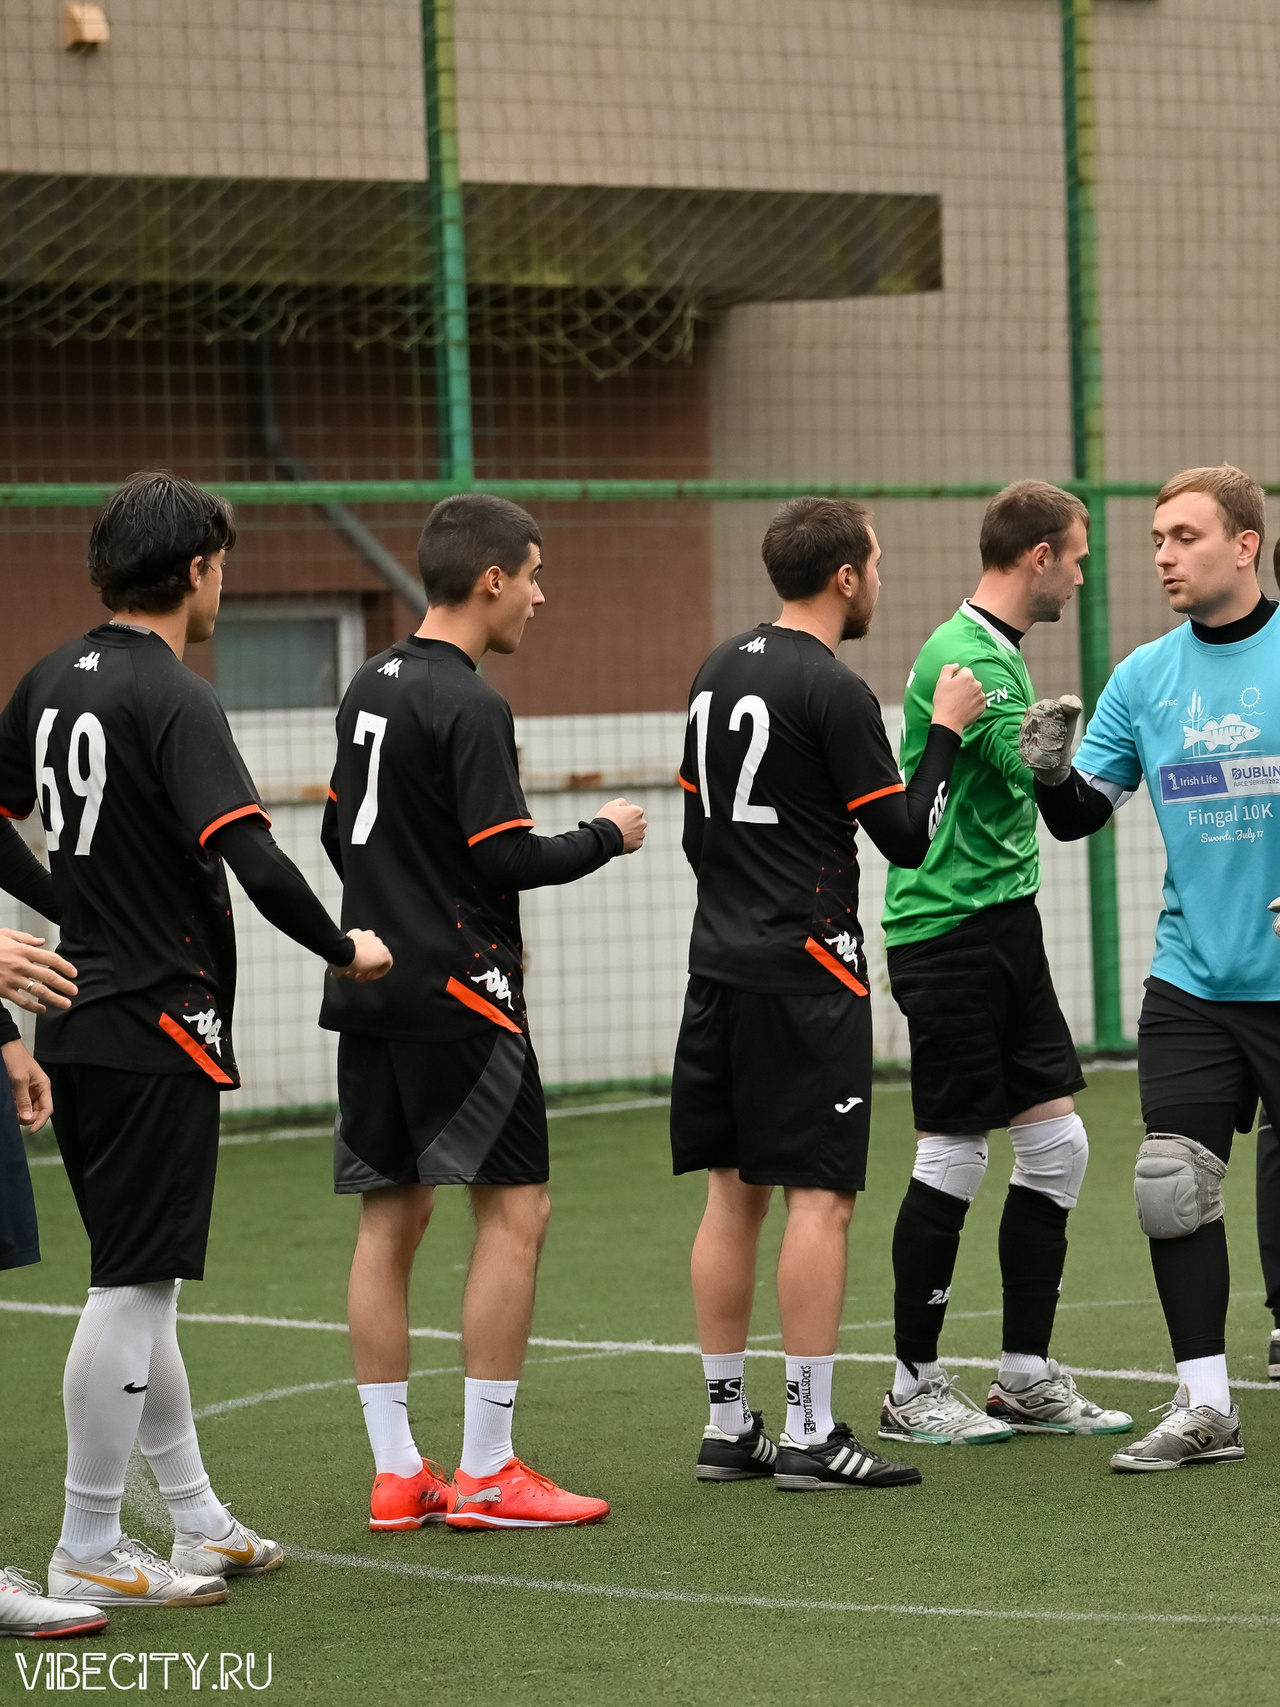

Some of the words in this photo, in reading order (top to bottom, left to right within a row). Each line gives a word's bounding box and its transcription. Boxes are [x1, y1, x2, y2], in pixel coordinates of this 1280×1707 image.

[689, 691, 777, 824] 12
[35, 708, 107, 856] 69
[351, 711, 388, 844] 7
[1180, 776, 1199, 787] Irish
[1201, 774, 1219, 785] Life
[1233, 780, 1248, 788] RACE
[1188, 806, 1238, 828] Fingal
[1243, 803, 1274, 821] 10K
[1200, 829, 1235, 844] Swords,
[1235, 828, 1257, 843] July
[1257, 830, 1264, 838] 17
[706, 1379, 740, 1403] FS
